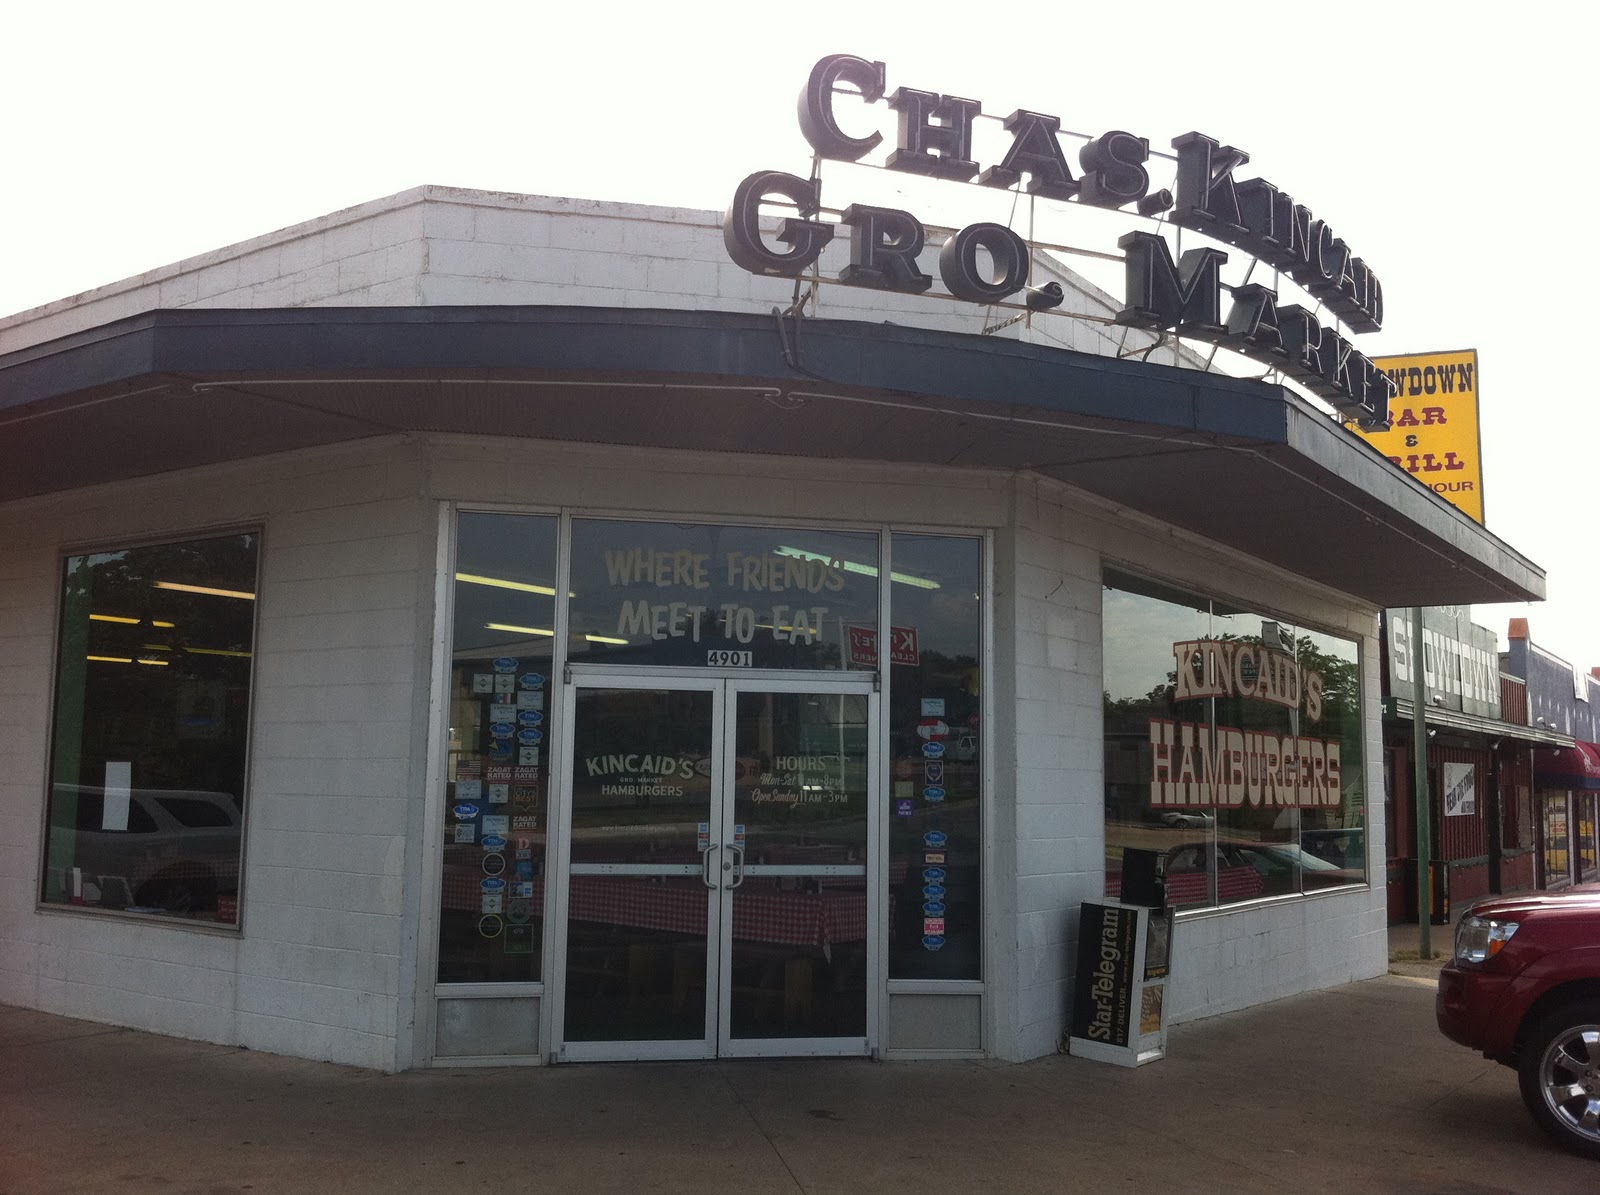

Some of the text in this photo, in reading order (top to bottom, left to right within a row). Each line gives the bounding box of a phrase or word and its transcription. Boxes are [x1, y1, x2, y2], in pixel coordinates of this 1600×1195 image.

[797, 54, 1173, 218] CHAS.
[723, 170, 1397, 431] GRO. MARKET
[1388, 363, 1473, 397] WDOWN
[1387, 452, 1465, 474] ILL
[1429, 481, 1474, 493] OUR
[605, 547, 847, 594] WHERE FRIENDS
[617, 600, 829, 645] MEET TO EAT
[708, 651, 750, 667] 4901
[1173, 640, 1323, 722] KINCAID'S
[585, 754, 694, 780] KINCAID'S
[775, 756, 826, 771] HOURS
[1149, 717, 1341, 808] HAMBURGERS
[601, 785, 683, 797] HAMBURGERS
[1088, 909, 1121, 1040] Star-Telegram
